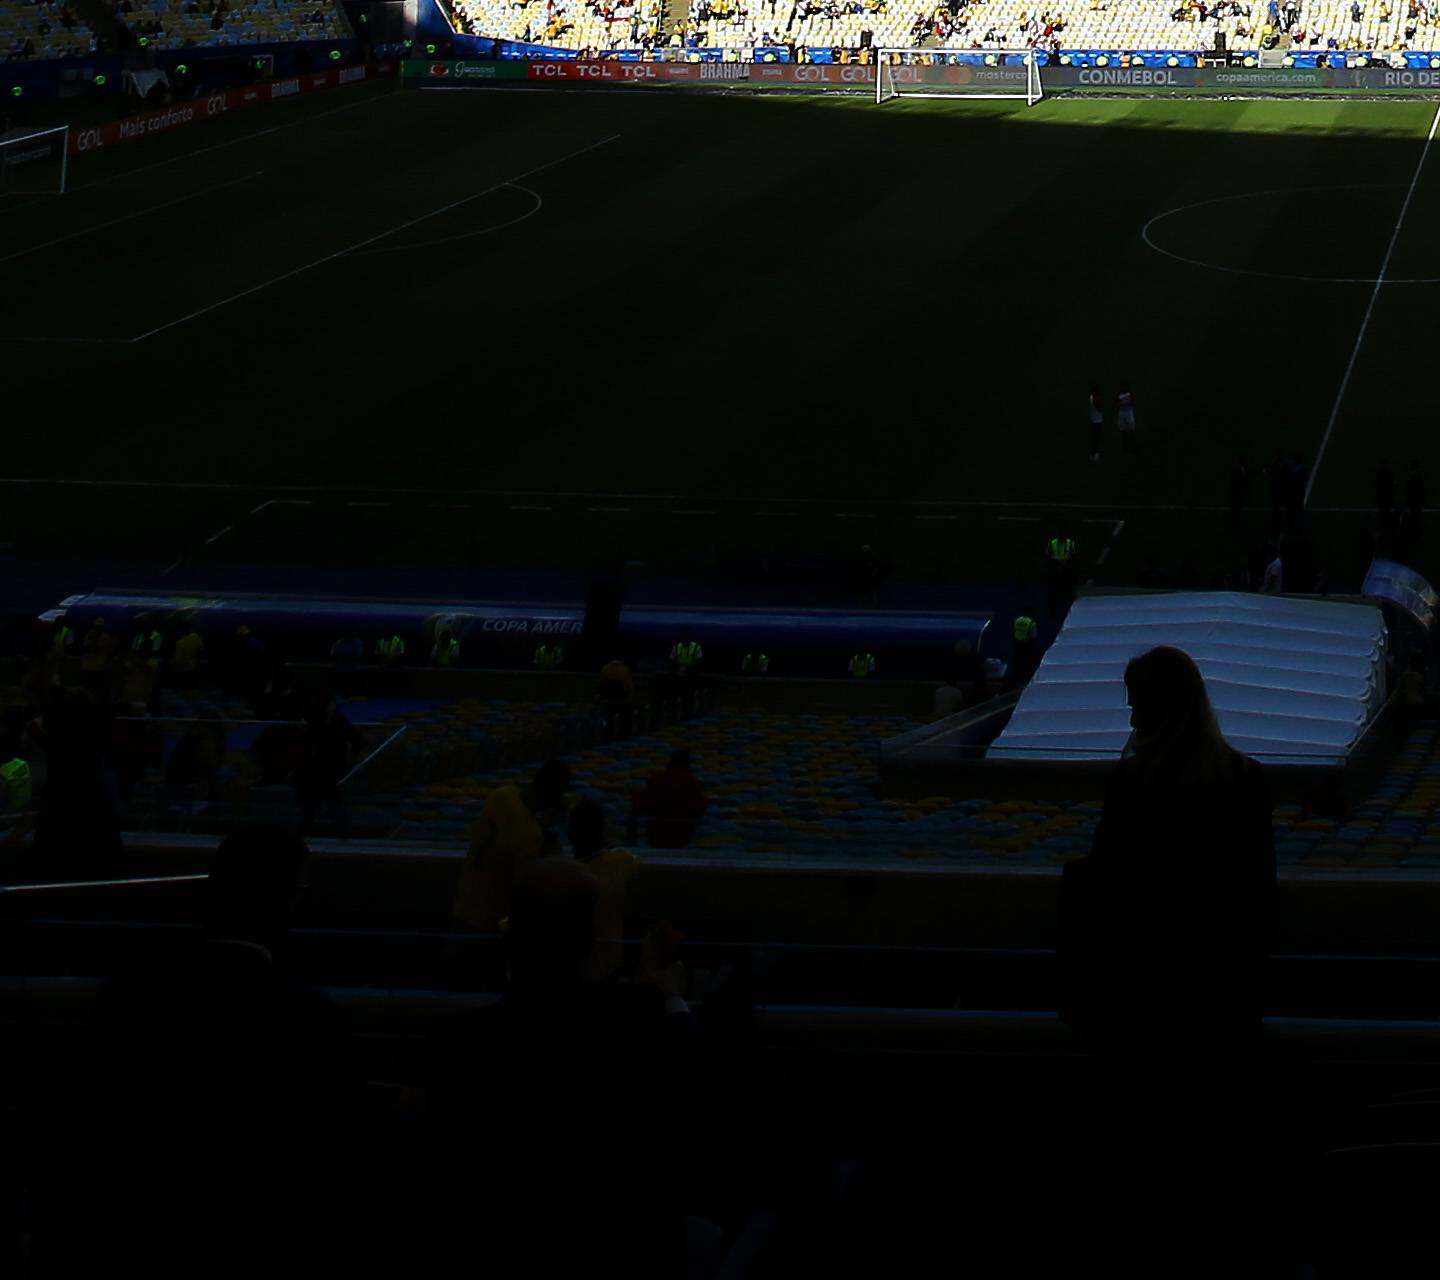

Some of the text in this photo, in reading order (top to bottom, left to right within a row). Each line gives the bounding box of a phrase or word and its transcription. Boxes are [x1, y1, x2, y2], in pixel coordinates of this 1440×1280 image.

[532, 64, 567, 76] TCL
[576, 64, 611, 77] TCL
[621, 65, 656, 77] TCL
[699, 63, 751, 80] BRAHMA
[795, 64, 828, 81] GOL
[840, 64, 875, 81] GOL
[976, 69, 1039, 80] mastercad
[1079, 70, 1176, 84] CONMEBOL
[1216, 71, 1316, 83] copaamerica.com
[1385, 72, 1412, 85] RIO
[1418, 72, 1439, 85] DE
[77, 128, 103, 151] GOL
[482, 617, 531, 633] COPA
